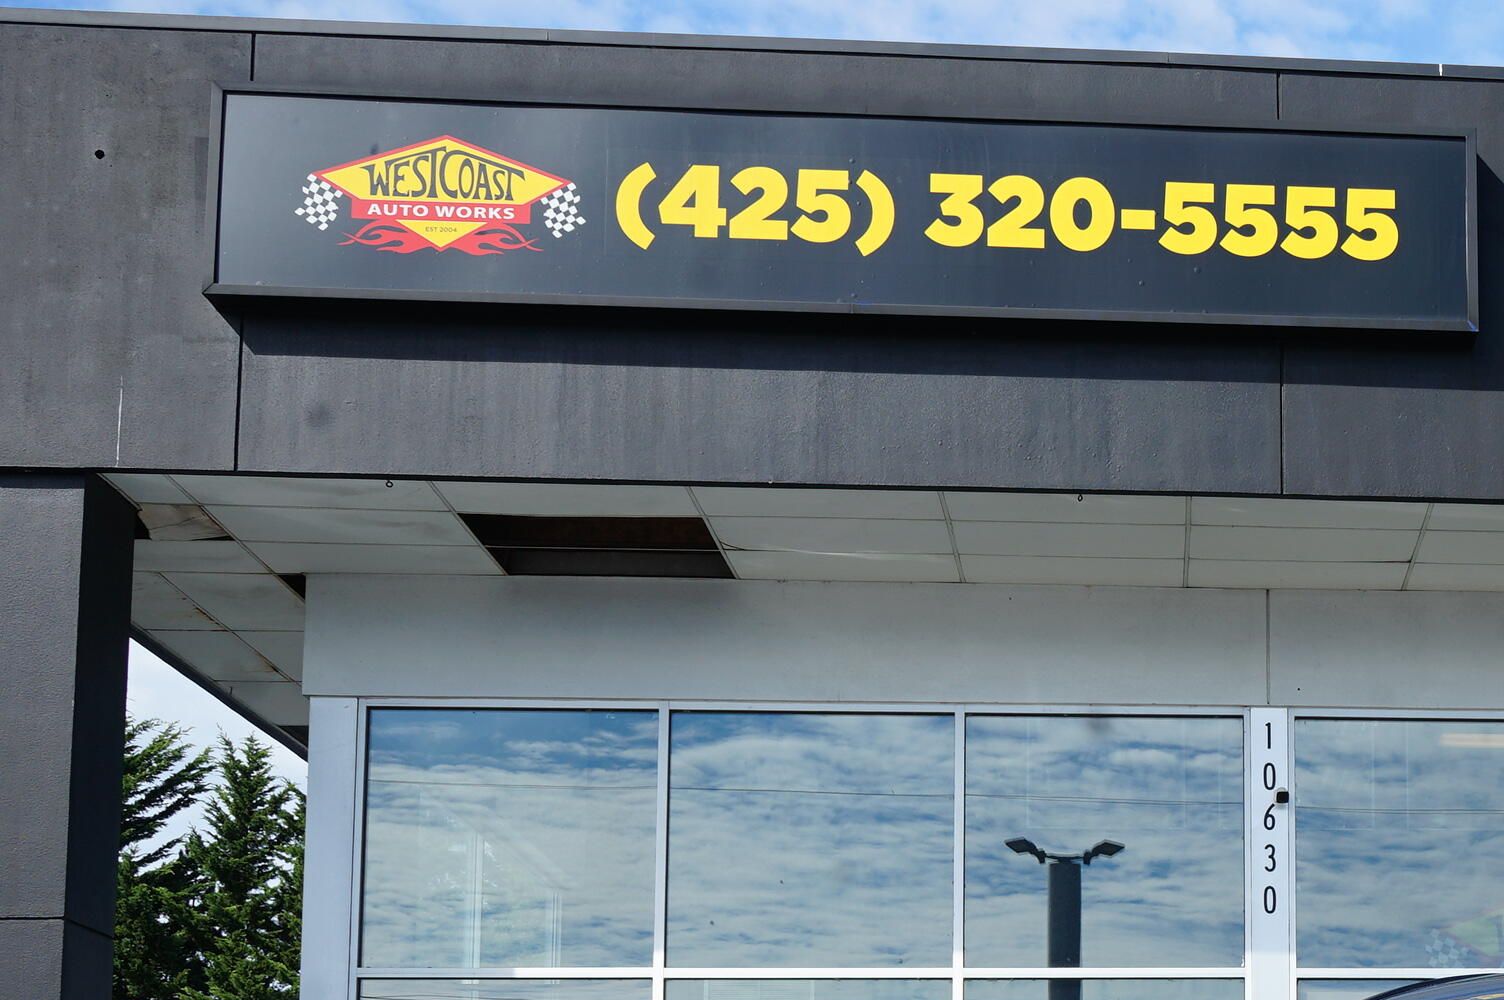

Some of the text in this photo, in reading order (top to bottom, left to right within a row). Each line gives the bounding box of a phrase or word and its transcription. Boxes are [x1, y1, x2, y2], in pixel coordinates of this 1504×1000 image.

[367, 203, 515, 220] AUTO WORKS
[616, 161, 1400, 262] (425) 320-5555
[1262, 721, 1277, 915] 10630
